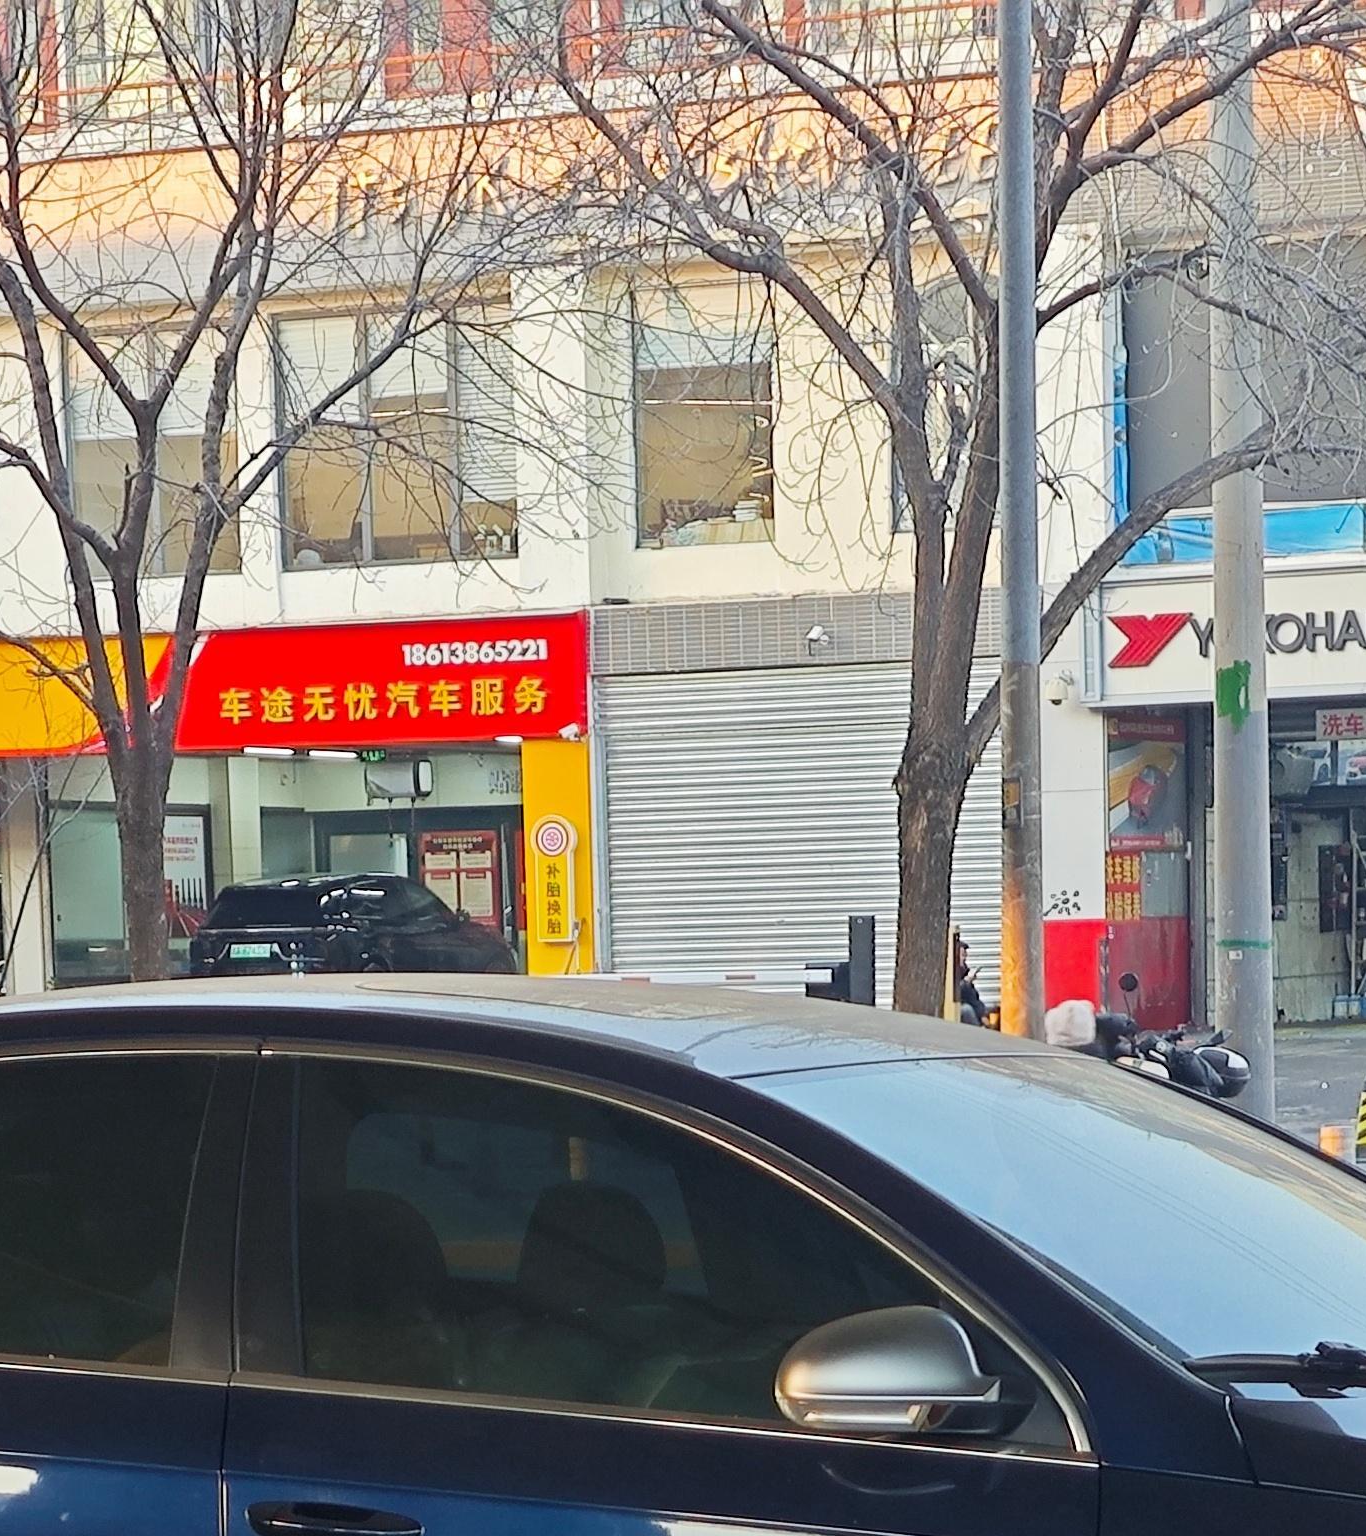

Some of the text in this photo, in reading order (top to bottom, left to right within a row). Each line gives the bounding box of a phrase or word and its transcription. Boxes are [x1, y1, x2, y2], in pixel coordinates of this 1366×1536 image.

[401, 638, 548, 667] 18613865221
[218, 675, 550, 725] 车途无忧汽车服务
[546, 862, 562, 935] 补胎换胎
